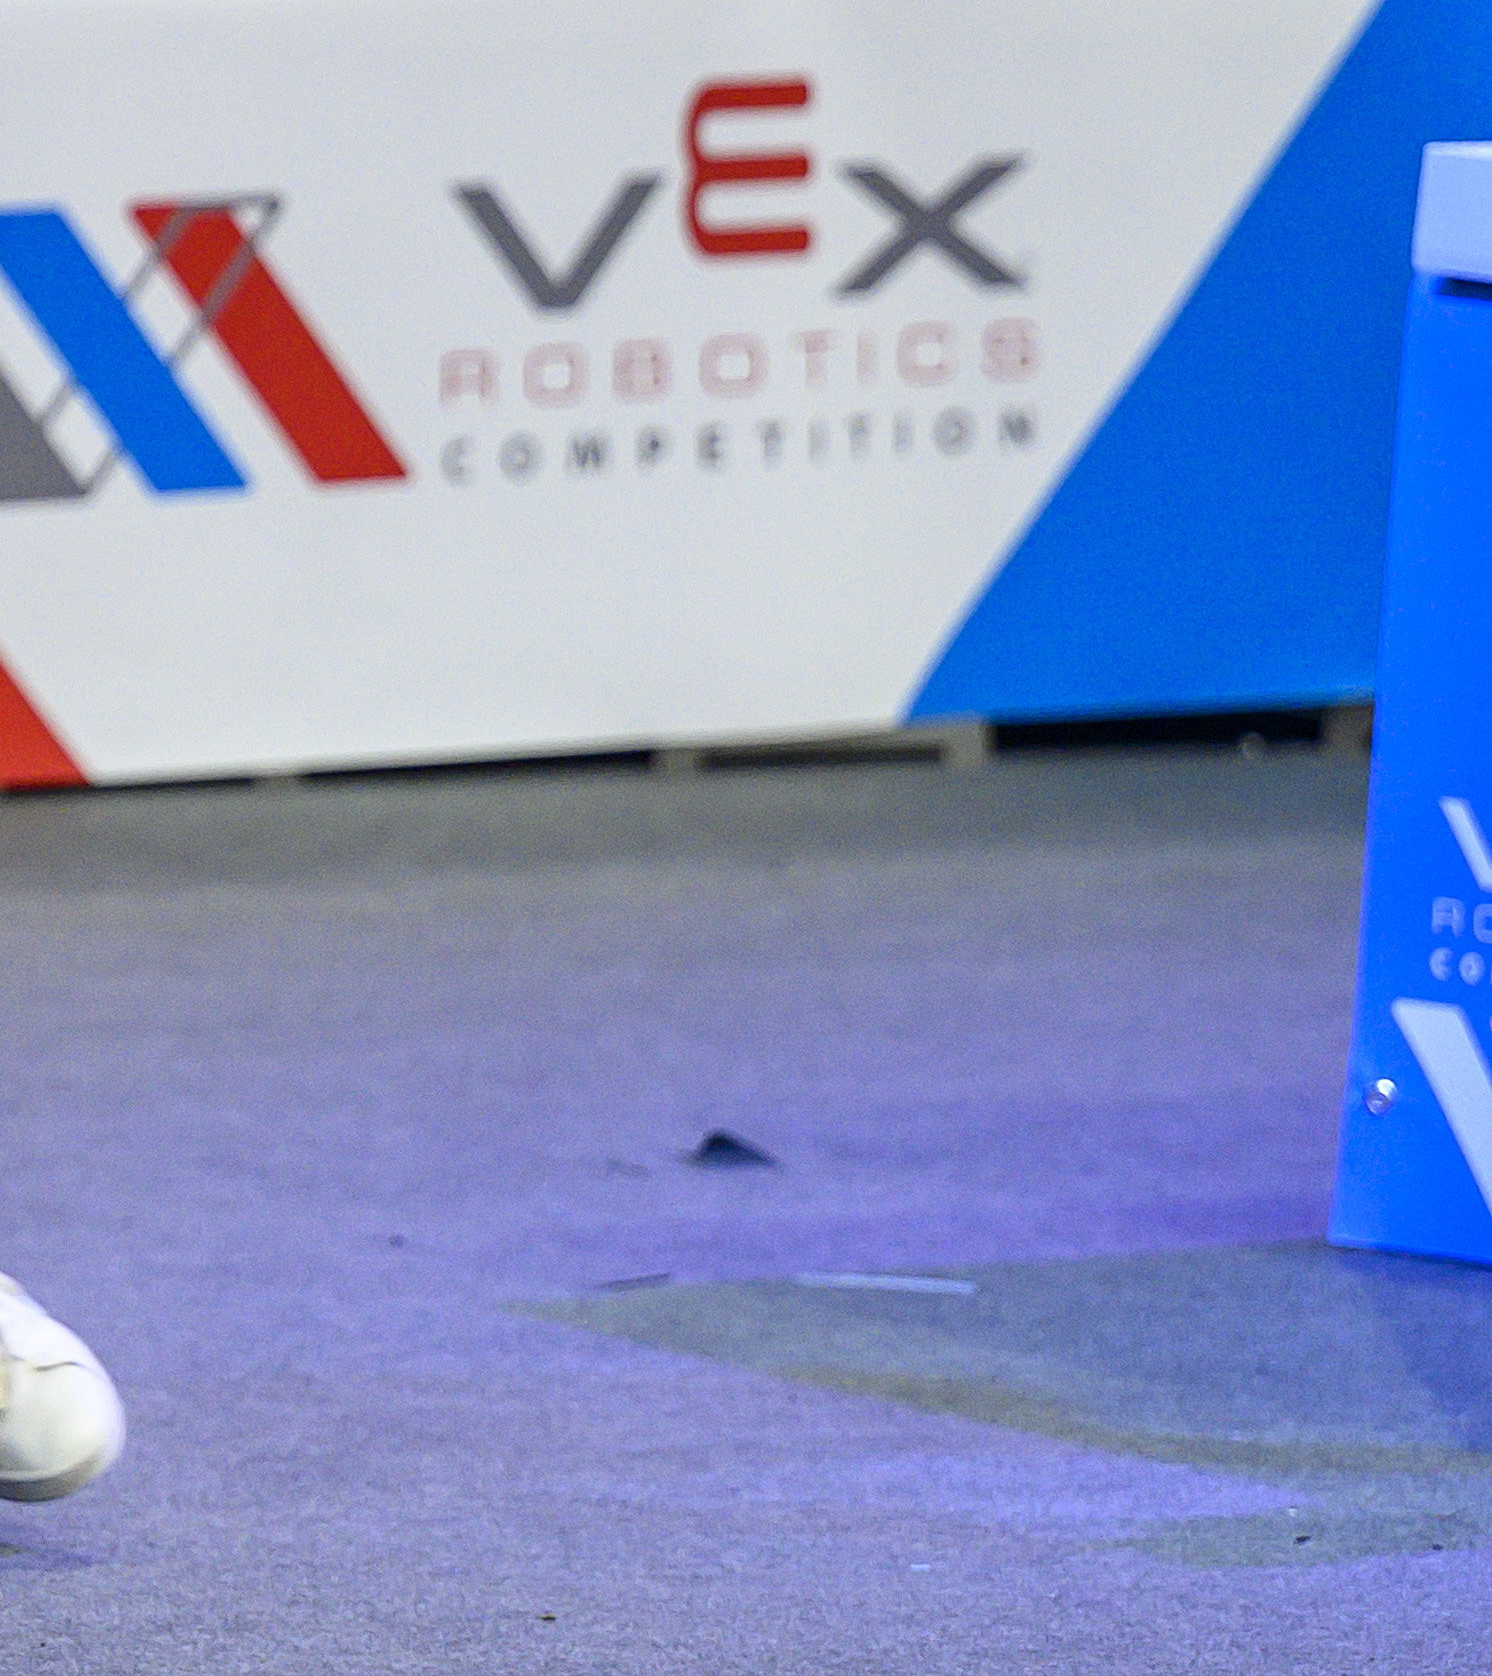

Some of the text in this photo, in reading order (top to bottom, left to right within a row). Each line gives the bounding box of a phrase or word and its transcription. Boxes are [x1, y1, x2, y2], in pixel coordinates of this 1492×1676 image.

[449, 73, 1024, 313] VEX
[438, 317, 1041, 408] ROBOTICS
[437, 407, 1039, 486] COMPETITION
